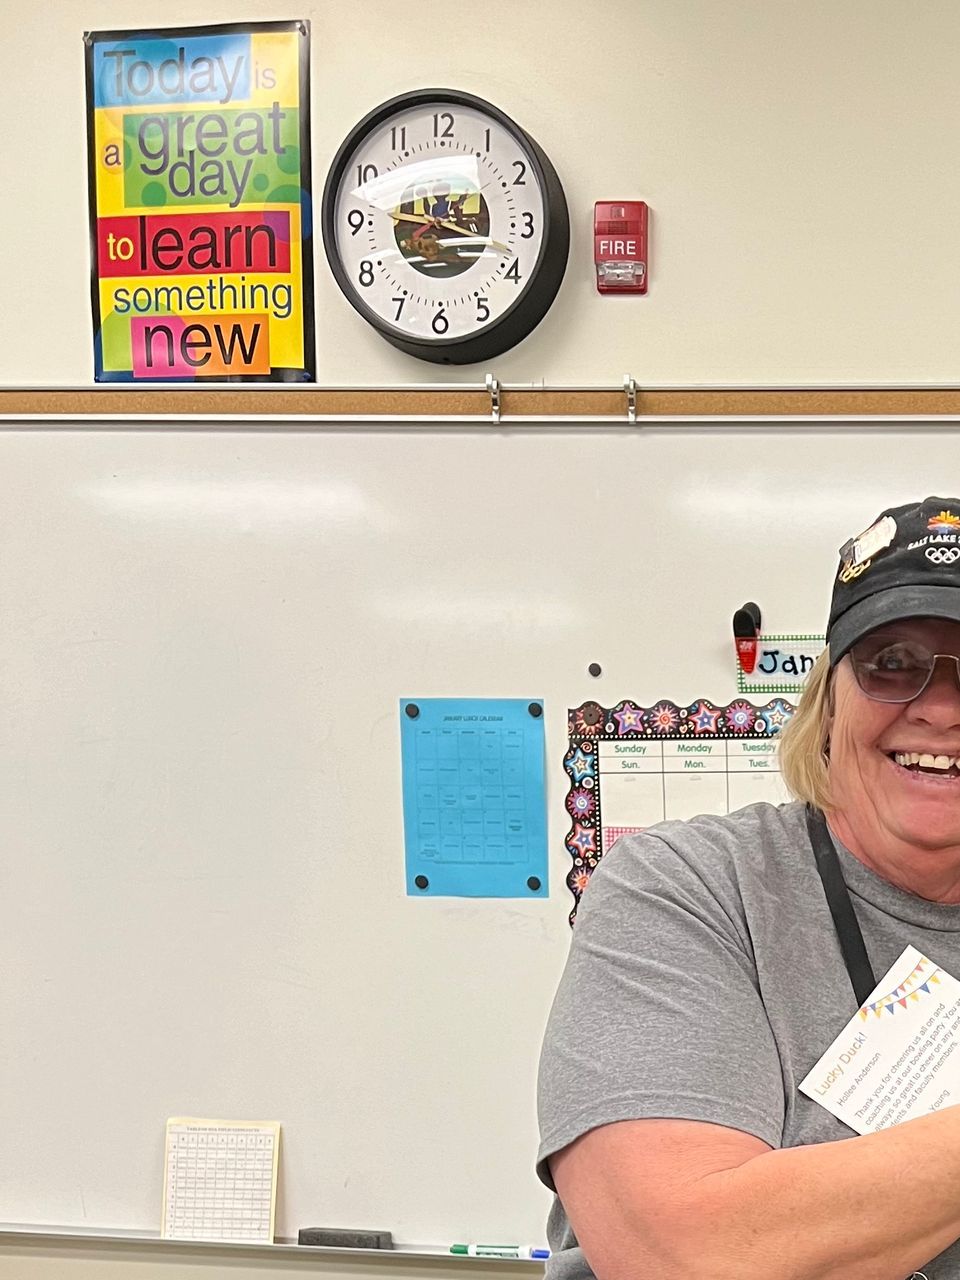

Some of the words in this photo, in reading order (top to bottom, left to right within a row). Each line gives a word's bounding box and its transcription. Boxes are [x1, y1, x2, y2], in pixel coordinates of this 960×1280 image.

[103, 47, 244, 104] Today
[255, 61, 276, 89] is
[433, 113, 455, 138] 12
[104, 144, 121, 166] a
[138, 101, 286, 176] great
[390, 127, 406, 151] 11
[484, 129, 491, 153] 1
[168, 150, 254, 208] day
[357, 164, 379, 187] 10
[511, 161, 527, 186] 2
[347, 209, 365, 236] 9
[520, 212, 535, 239] 3
[107, 233, 134, 261] to
[139, 215, 276, 271] learn
[600, 240, 636, 255] FIRE
[358, 260, 375, 287] 8
[503, 257, 522, 285] 4
[114, 276, 292, 319] something
[391, 297, 406, 322] 7
[476, 297, 491, 322] 5
[431, 309, 449, 335] 6
[144, 323, 261, 368] new
[907, 536, 929, 551] SALT
[929, 534, 957, 544] LAKE
[759, 650, 819, 675] Jan
[614, 744, 647, 754] Sunday
[677, 743, 713, 754] Monday
[742, 743, 776, 753] Tuesday
[621, 760, 641, 769] Sun.
[684, 759, 707, 769] Mon.
[748, 759, 770, 768] Tues.
[815, 1065, 844, 1095] Lucky
[840, 1032, 865, 1064] Duck!
[855, 1098, 873, 1118] Thank
[873, 1084, 884, 1098] you
[882, 1074, 891, 1084] for
[891, 1046, 915, 1073] cheering
[920, 1026, 928, 1036] all
[927, 1018, 935, 1026] on
[934, 1003, 945, 1017] and
[855, 1053, 881, 1085] Anderson
[866, 1096, 891, 1125] coaching
[902, 1066, 911, 1077] our
[910, 1040, 933, 1065] bowling
[943, 1007, 957, 1019] You
[875, 1109, 894, 1132] always
[893, 1099, 901, 1108] so
[900, 1080, 915, 1099] great
[920, 1053, 935, 1072] cheer
[934, 1044, 942, 1052] on
[942, 1031, 953, 1043] any
[891, 1110, 907, 1126] dents
[906, 1095, 917, 1109] and
[915, 1072, 934, 1095] faculty
[930, 1090, 950, 1112] Young
